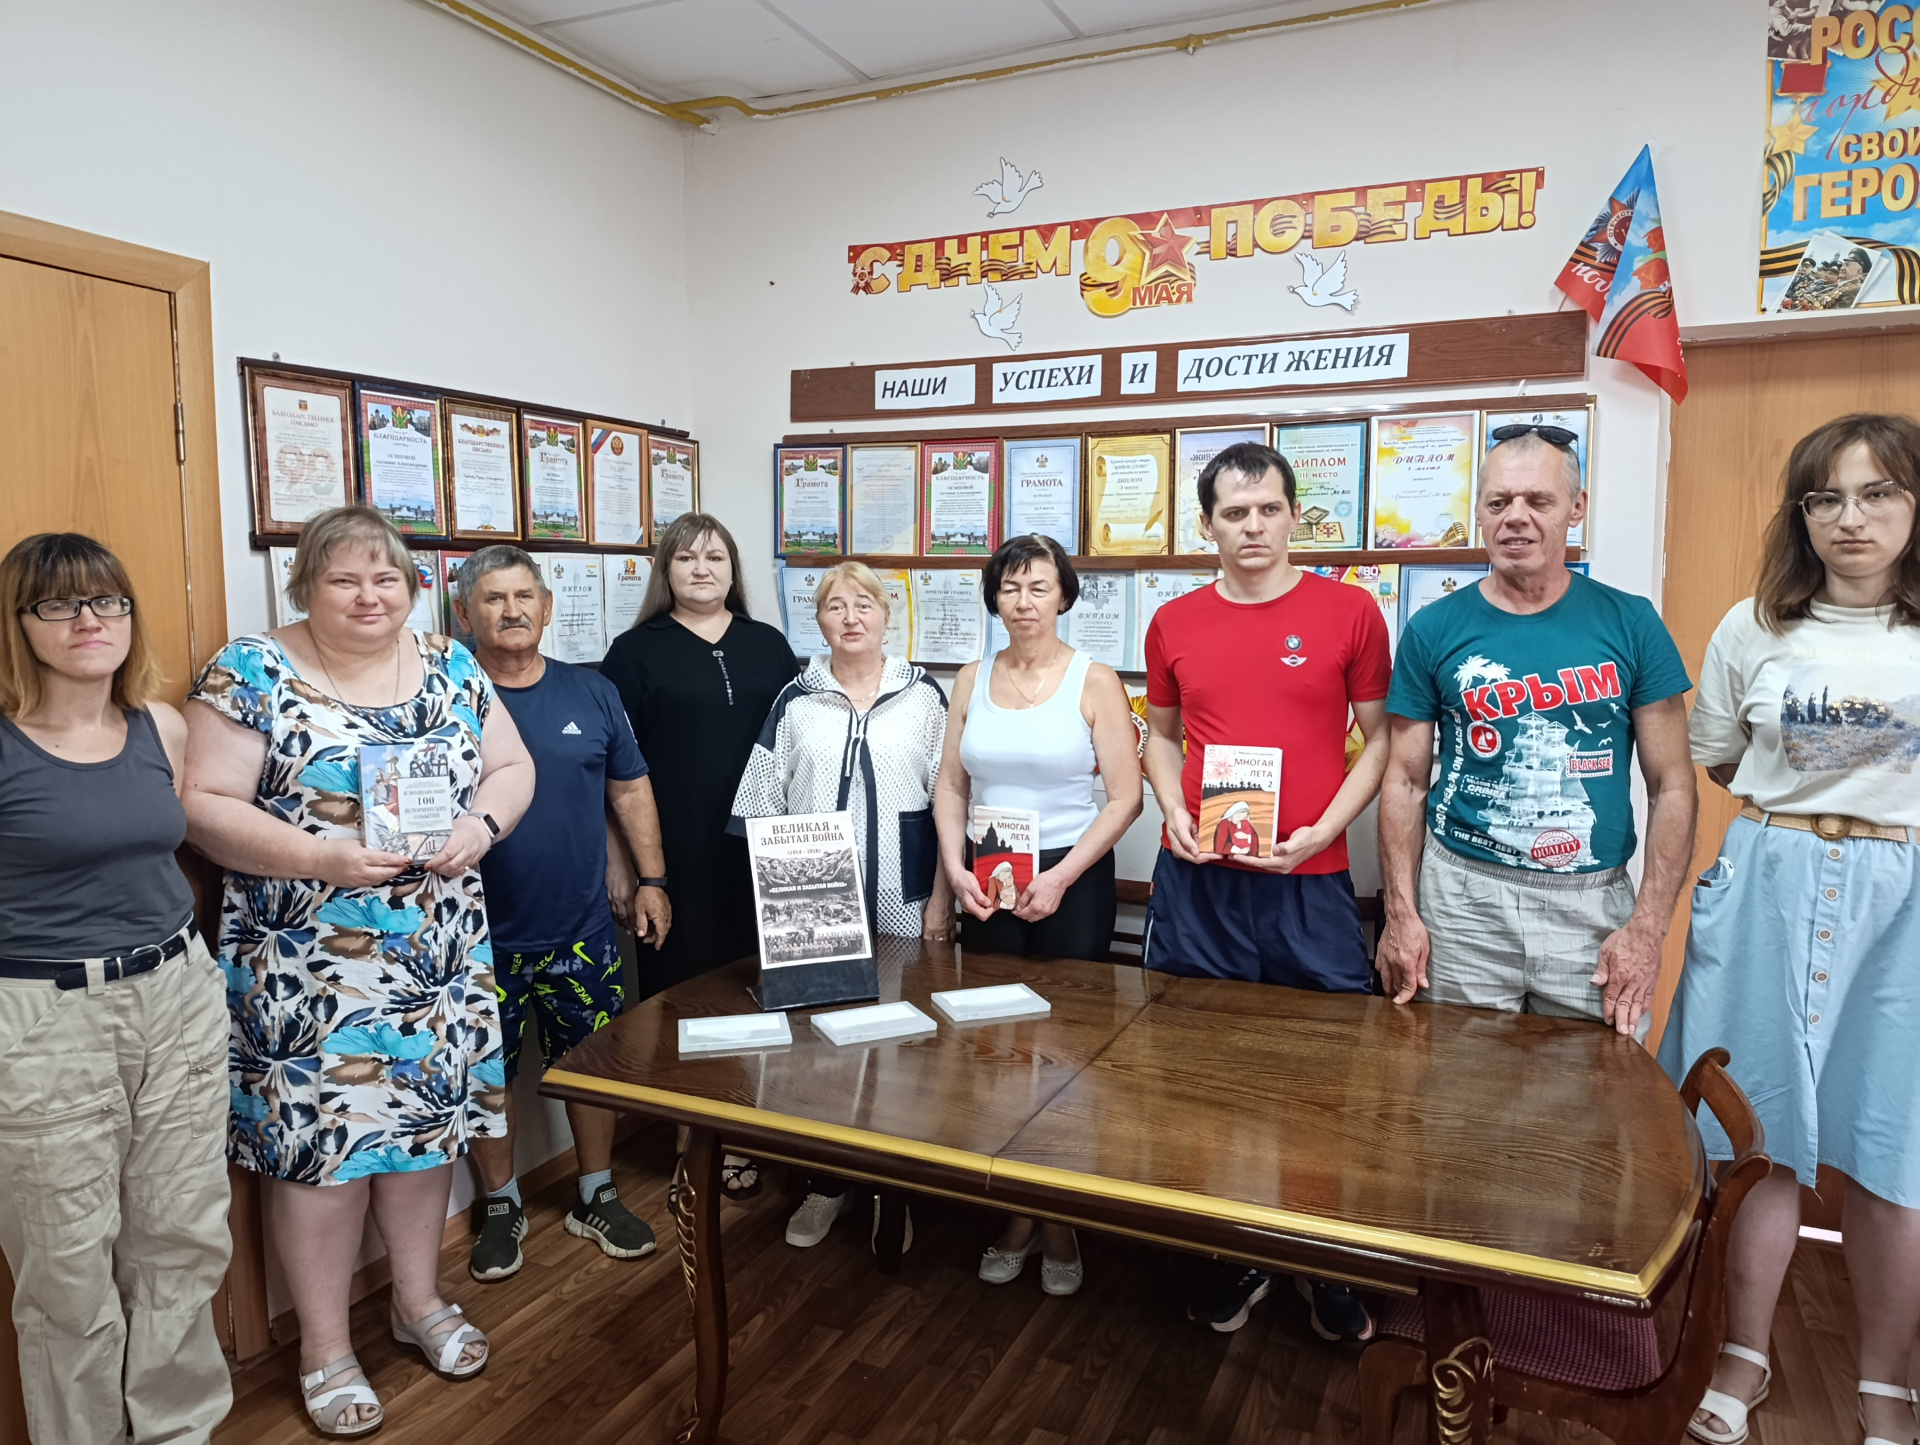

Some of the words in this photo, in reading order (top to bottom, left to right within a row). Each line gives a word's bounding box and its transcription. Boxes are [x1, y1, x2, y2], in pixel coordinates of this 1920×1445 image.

[1792, 163, 1920, 223] ГЕРО
[897, 224, 1072, 292] ДНЕМ
[1209, 170, 1538, 261] ПОБЕДЫ!
[1131, 282, 1195, 307] МАЯ
[881, 376, 948, 399] НАШИ
[998, 364, 1095, 394] УСПЕХИ
[1128, 363, 1149, 385] И
[373, 433, 428, 444] БЛАГОДАРНОСТЬ
[540, 452, 569, 466] Грамота
[1292, 457, 1346, 468] ДИПЛОМ
[1393, 453, 1455, 465] ДИПЛОМ
[661, 469, 685, 481] Грамота
[795, 478, 828, 489] Грамота
[1021, 479, 1063, 488] ГРАМОТА
[1363, 566, 1379, 576] 80
[618, 573, 642, 582] Грамота
[1078, 612, 1119, 620] ДИПЛОМ
[1462, 661, 1622, 722] КРЫМ
[1234, 758, 1274, 768] МНОГАЯ
[1451, 756, 1464, 771] ON
[1571, 758, 1597, 771] BLACK
[1598, 757, 1611, 770] SEA
[1249, 769, 1273, 778] ЛЕТА
[1467, 784, 1506, 799] CRIMEA
[417, 796, 435, 806] 100
[772, 821, 830, 835] ВЕЛИКАЯ
[997, 821, 1030, 831] МНОГАЯ
[760, 834, 809, 846] ЗАБЫТАЯ
[812, 831, 845, 842] ВОЙНА
[1010, 833, 1030, 841] ЛЕТА
[1454, 830, 1470, 842] THE
[1471, 834, 1493, 848] BEST
[1495, 843, 1518, 855] REST
[1533, 840, 1578, 859] QUALITY
[802, 883, 827, 891] ЗАБЫТАЯ
[574, 985, 594, 1006] NIKE
